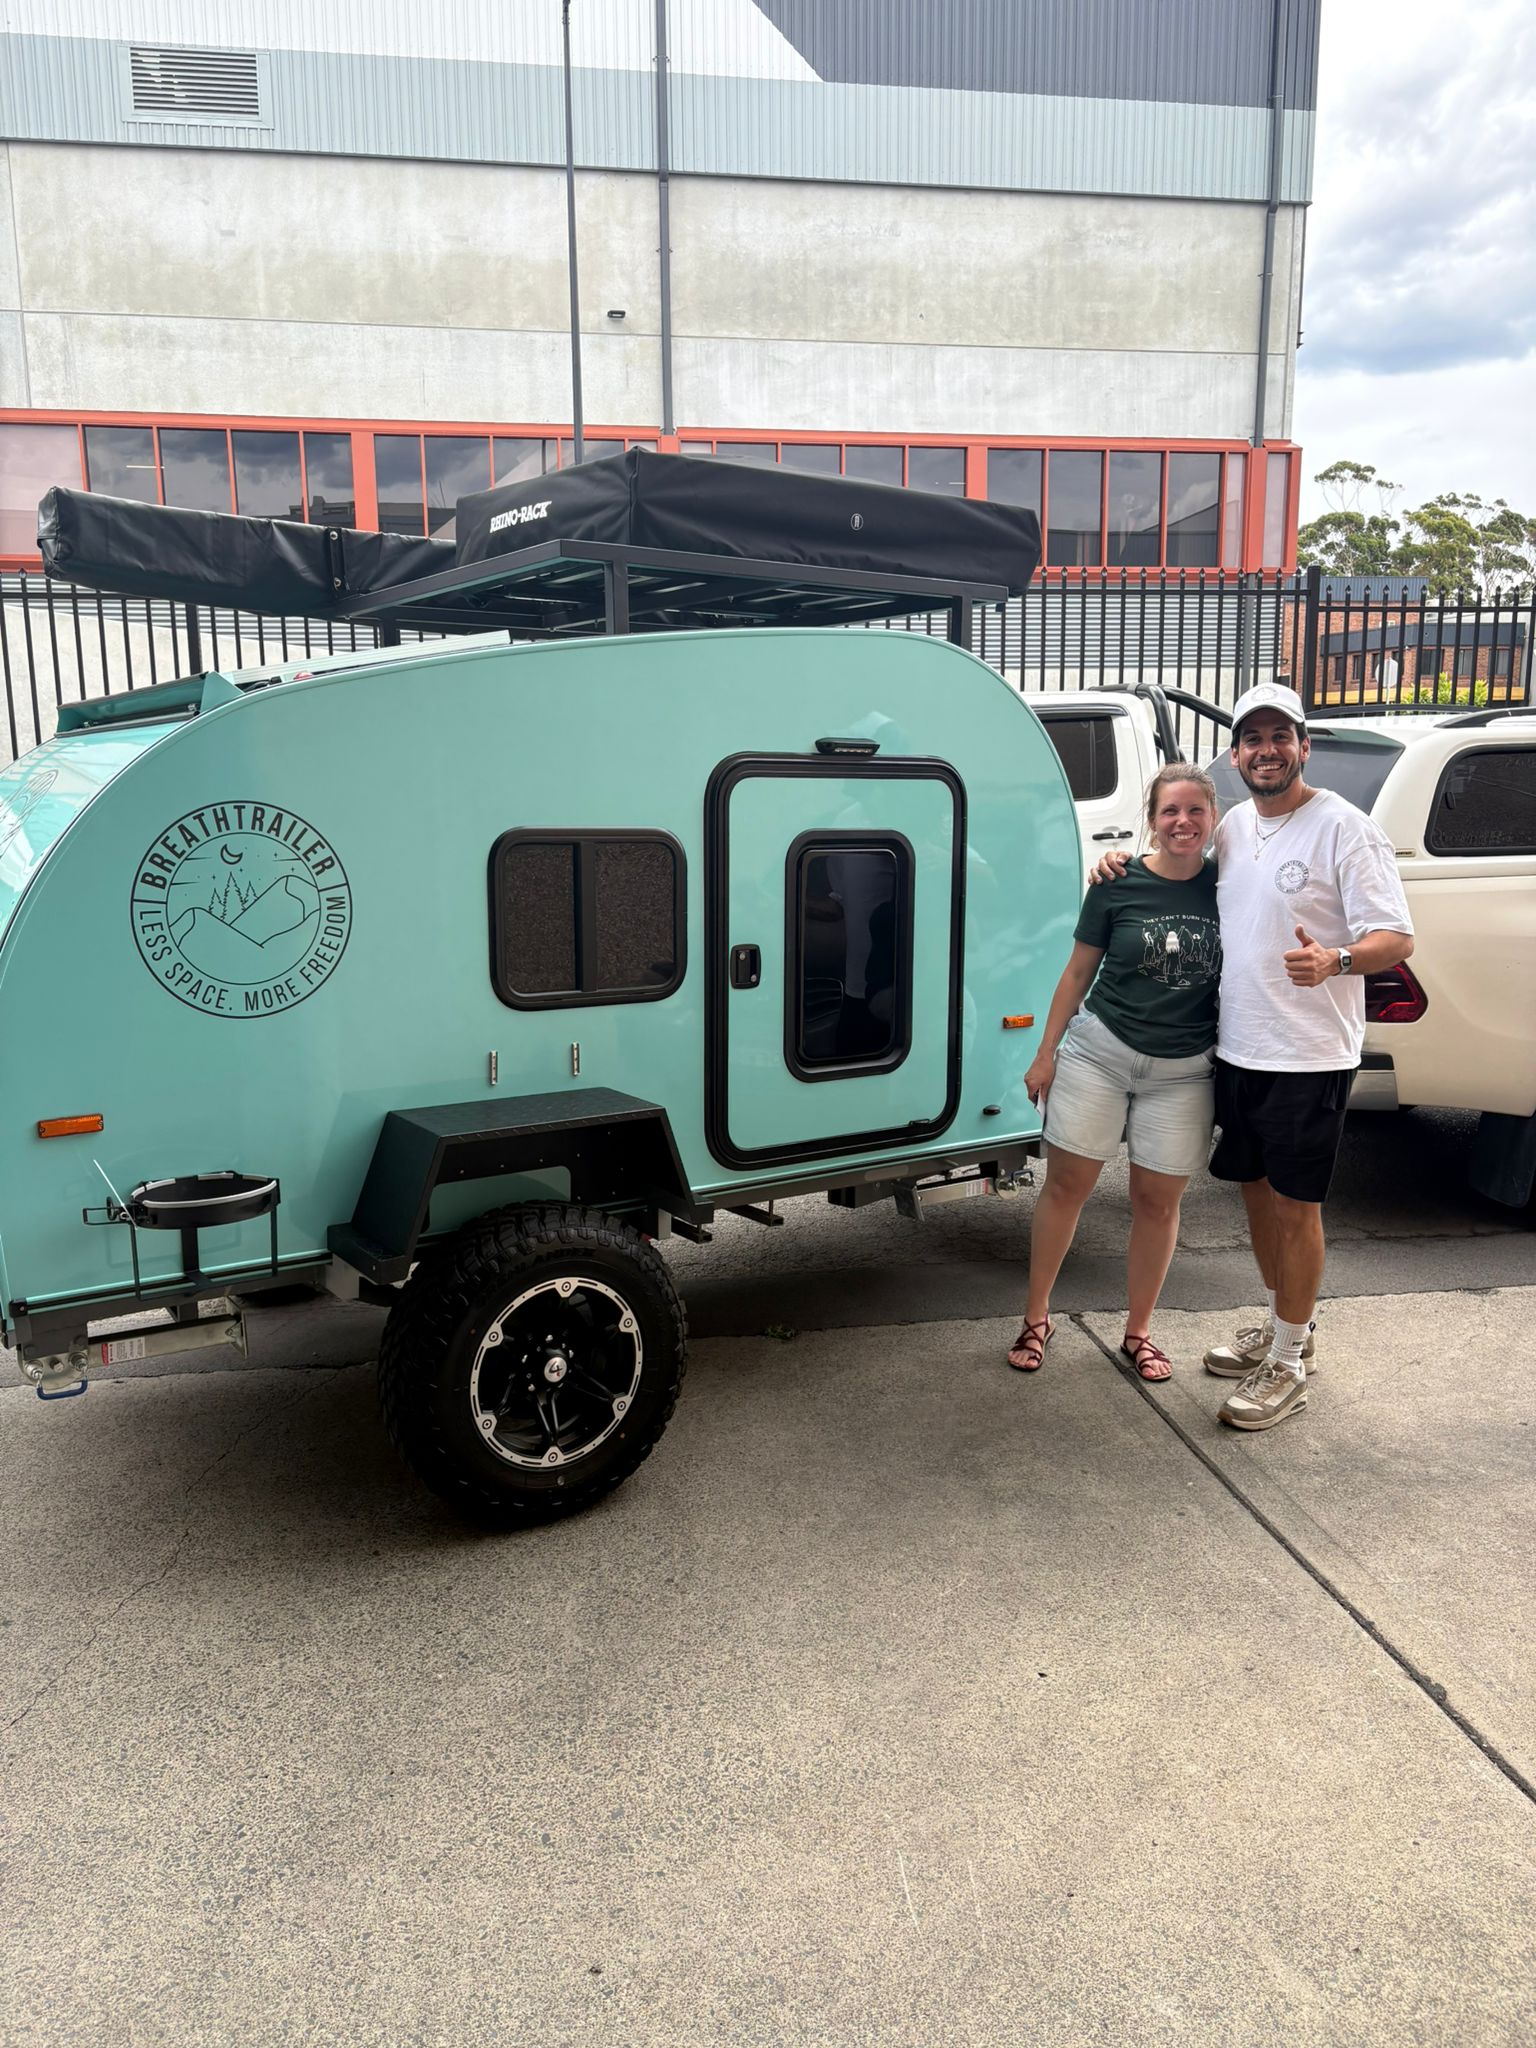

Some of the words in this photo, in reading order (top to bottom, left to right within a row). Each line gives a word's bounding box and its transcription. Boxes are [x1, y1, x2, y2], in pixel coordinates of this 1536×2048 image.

[489, 500, 553, 534] RHINO-RACK
[139, 804, 336, 890] BREATHTRAILER
[1142, 917, 1159, 925] THEY
[139, 909, 173, 962] LESS
[164, 961, 234, 1011] SPACE.
[244, 977, 301, 1012] MORE
[299, 895, 347, 986] FREEDOM
